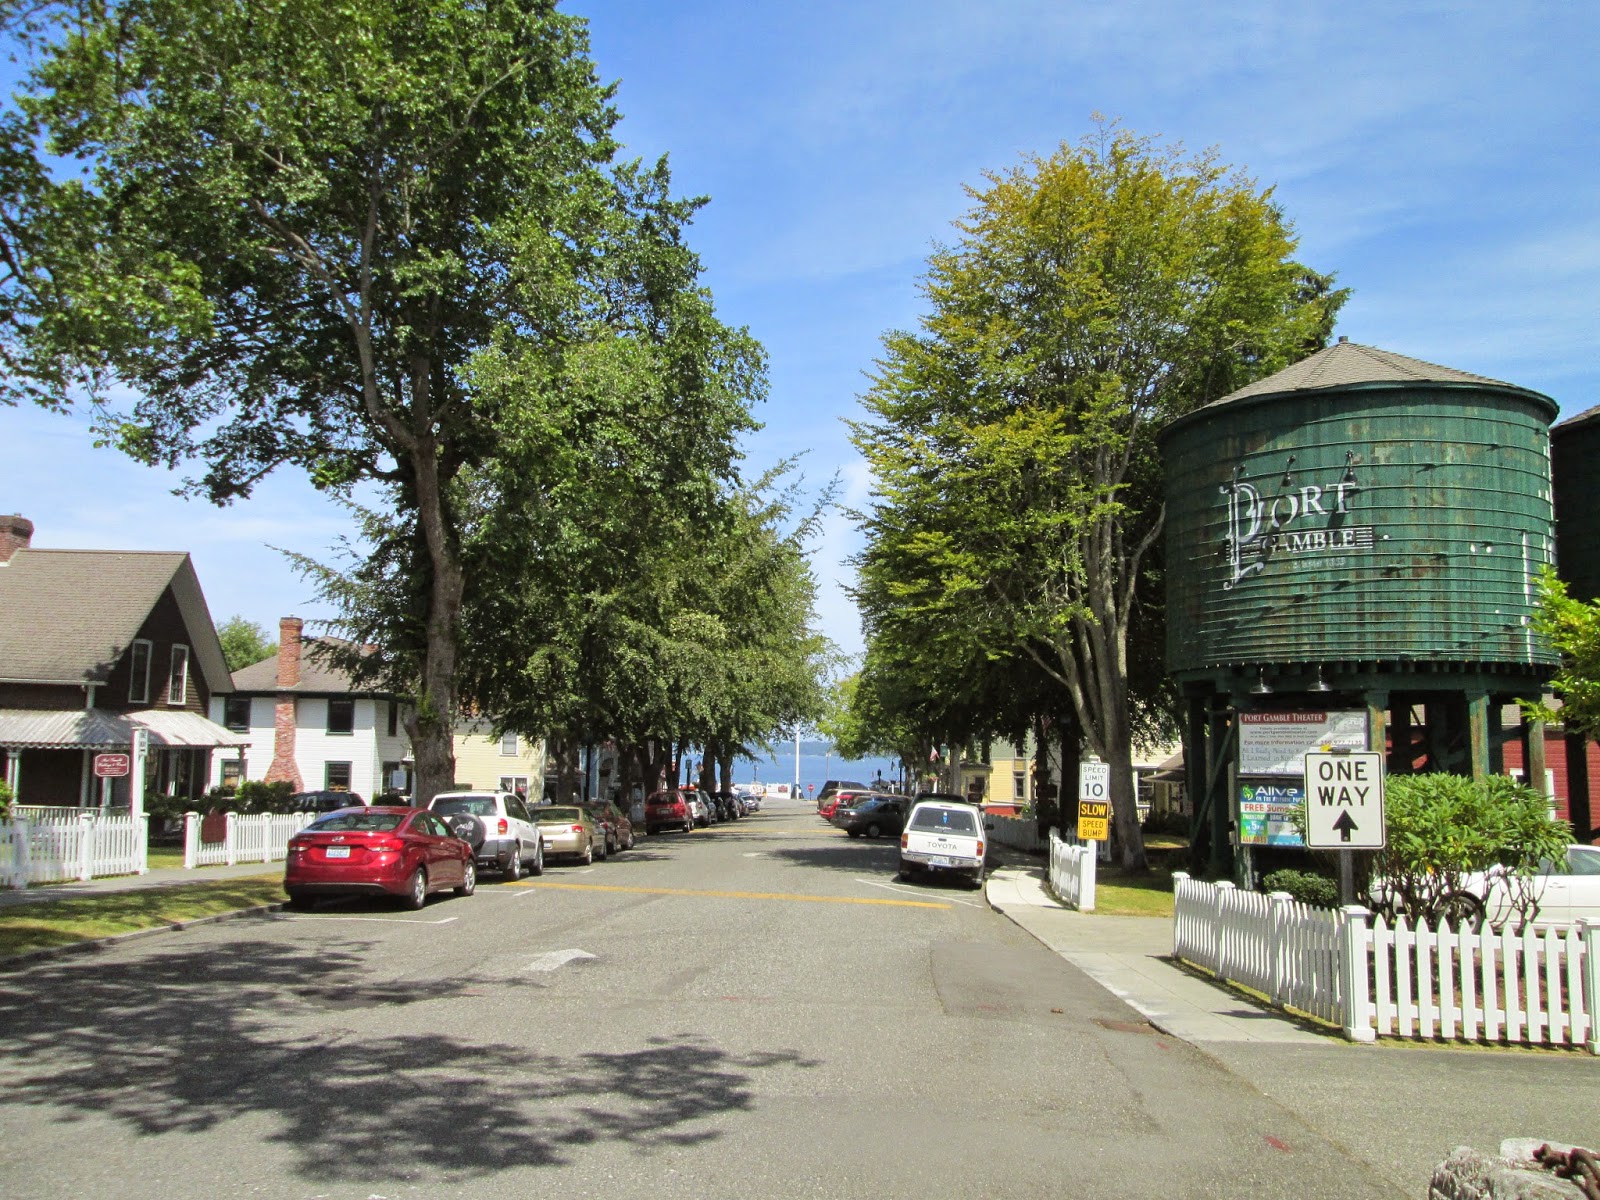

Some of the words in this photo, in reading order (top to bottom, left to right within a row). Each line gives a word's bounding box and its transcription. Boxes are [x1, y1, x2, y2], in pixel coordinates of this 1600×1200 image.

[1244, 713, 1262, 722] PORT
[1263, 713, 1291, 722] GAMBLE
[1292, 713, 1324, 721] THEATER
[1083, 766, 1107, 774] SPEED
[1319, 761, 1367, 781] ONE
[1085, 783, 1103, 796] 10
[1255, 785, 1298, 797] Alive
[1318, 786, 1370, 806] WAY
[1081, 804, 1106, 816] SLOW
[1244, 803, 1264, 811] FREE
[1082, 819, 1104, 828] SPEED
[1082, 829, 1103, 837] BUMP
[927, 841, 958, 850] TOYOTA
